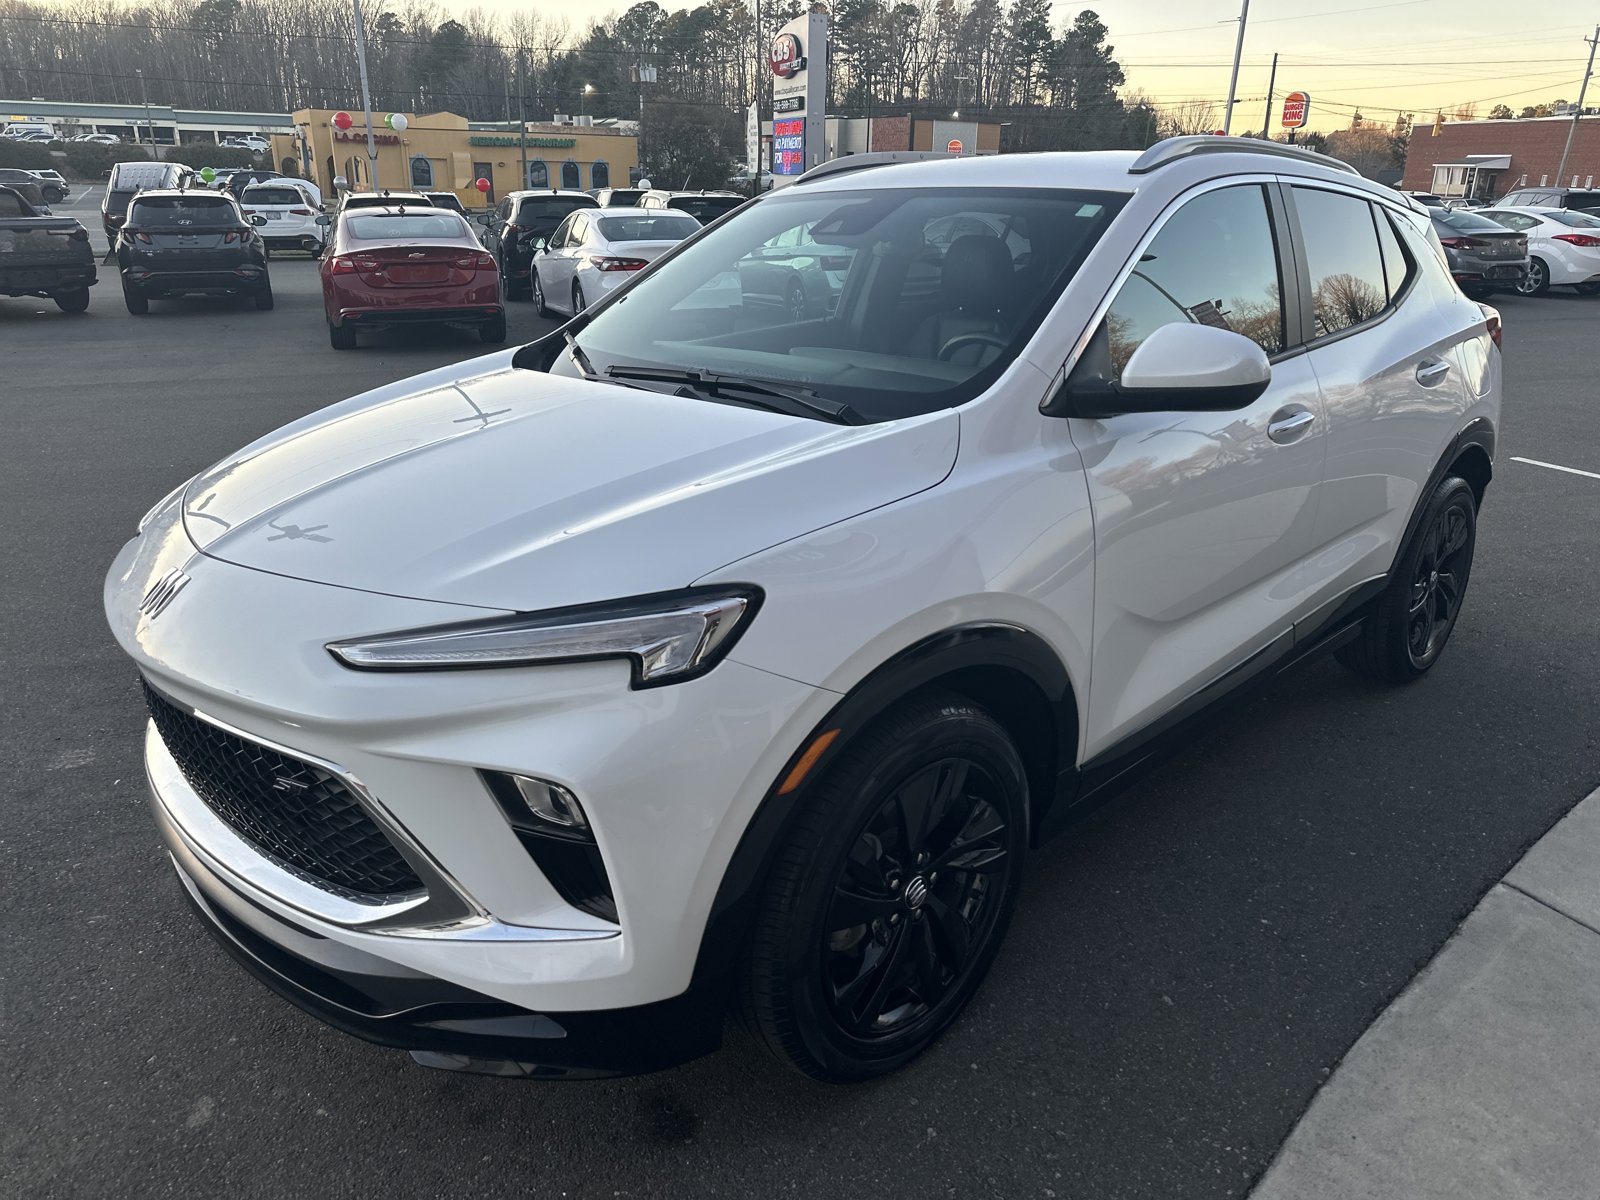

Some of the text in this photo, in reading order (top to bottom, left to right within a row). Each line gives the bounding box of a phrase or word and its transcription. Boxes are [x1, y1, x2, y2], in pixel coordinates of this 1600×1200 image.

[1284, 103, 1304, 111] BURGER
[1283, 110, 1303, 120] KING
[335, 132, 349, 143] LA
[469, 136, 514, 147] MEXICAN
